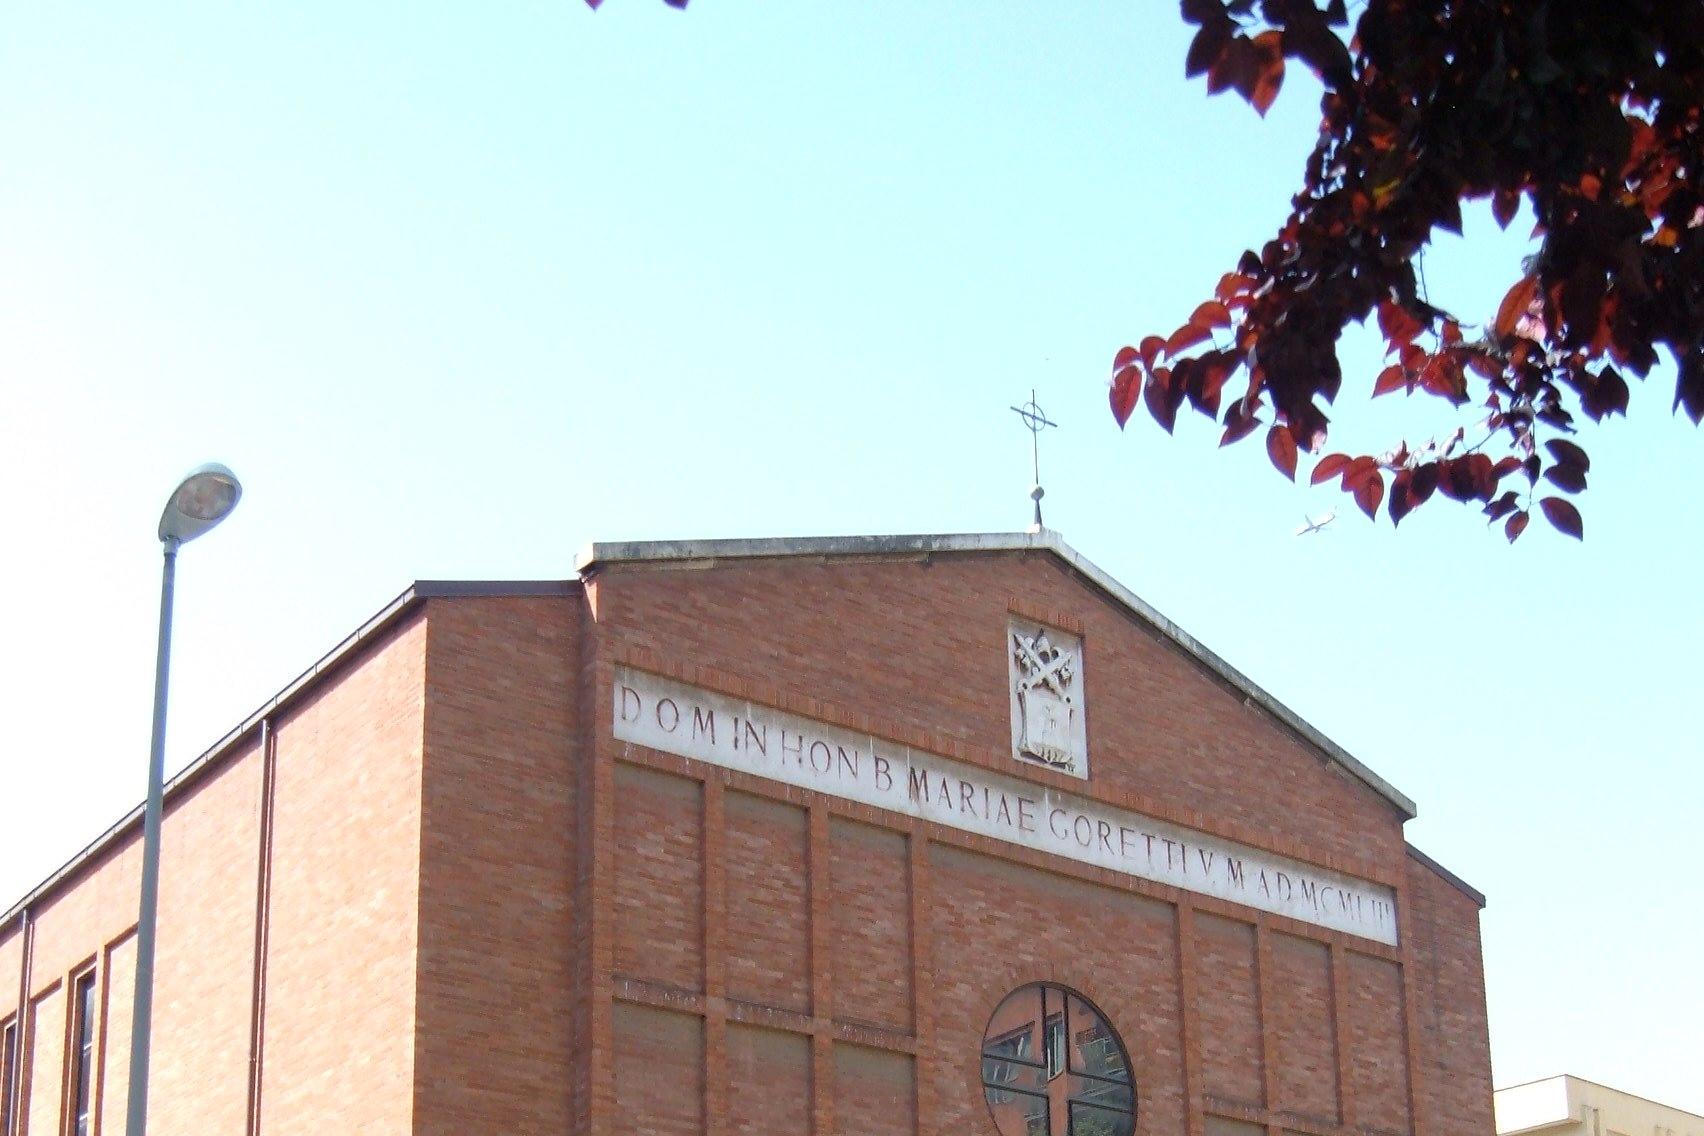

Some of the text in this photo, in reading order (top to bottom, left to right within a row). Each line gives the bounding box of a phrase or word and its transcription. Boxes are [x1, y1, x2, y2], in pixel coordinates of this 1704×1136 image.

[620, 686, 716, 745] DOM
[733, 716, 768, 757] IN
[780, 730, 859, 780] HON
[874, 754, 893, 792] B
[908, 766, 1036, 833] MARIAE
[1049, 808, 1187, 875] GORETTI
